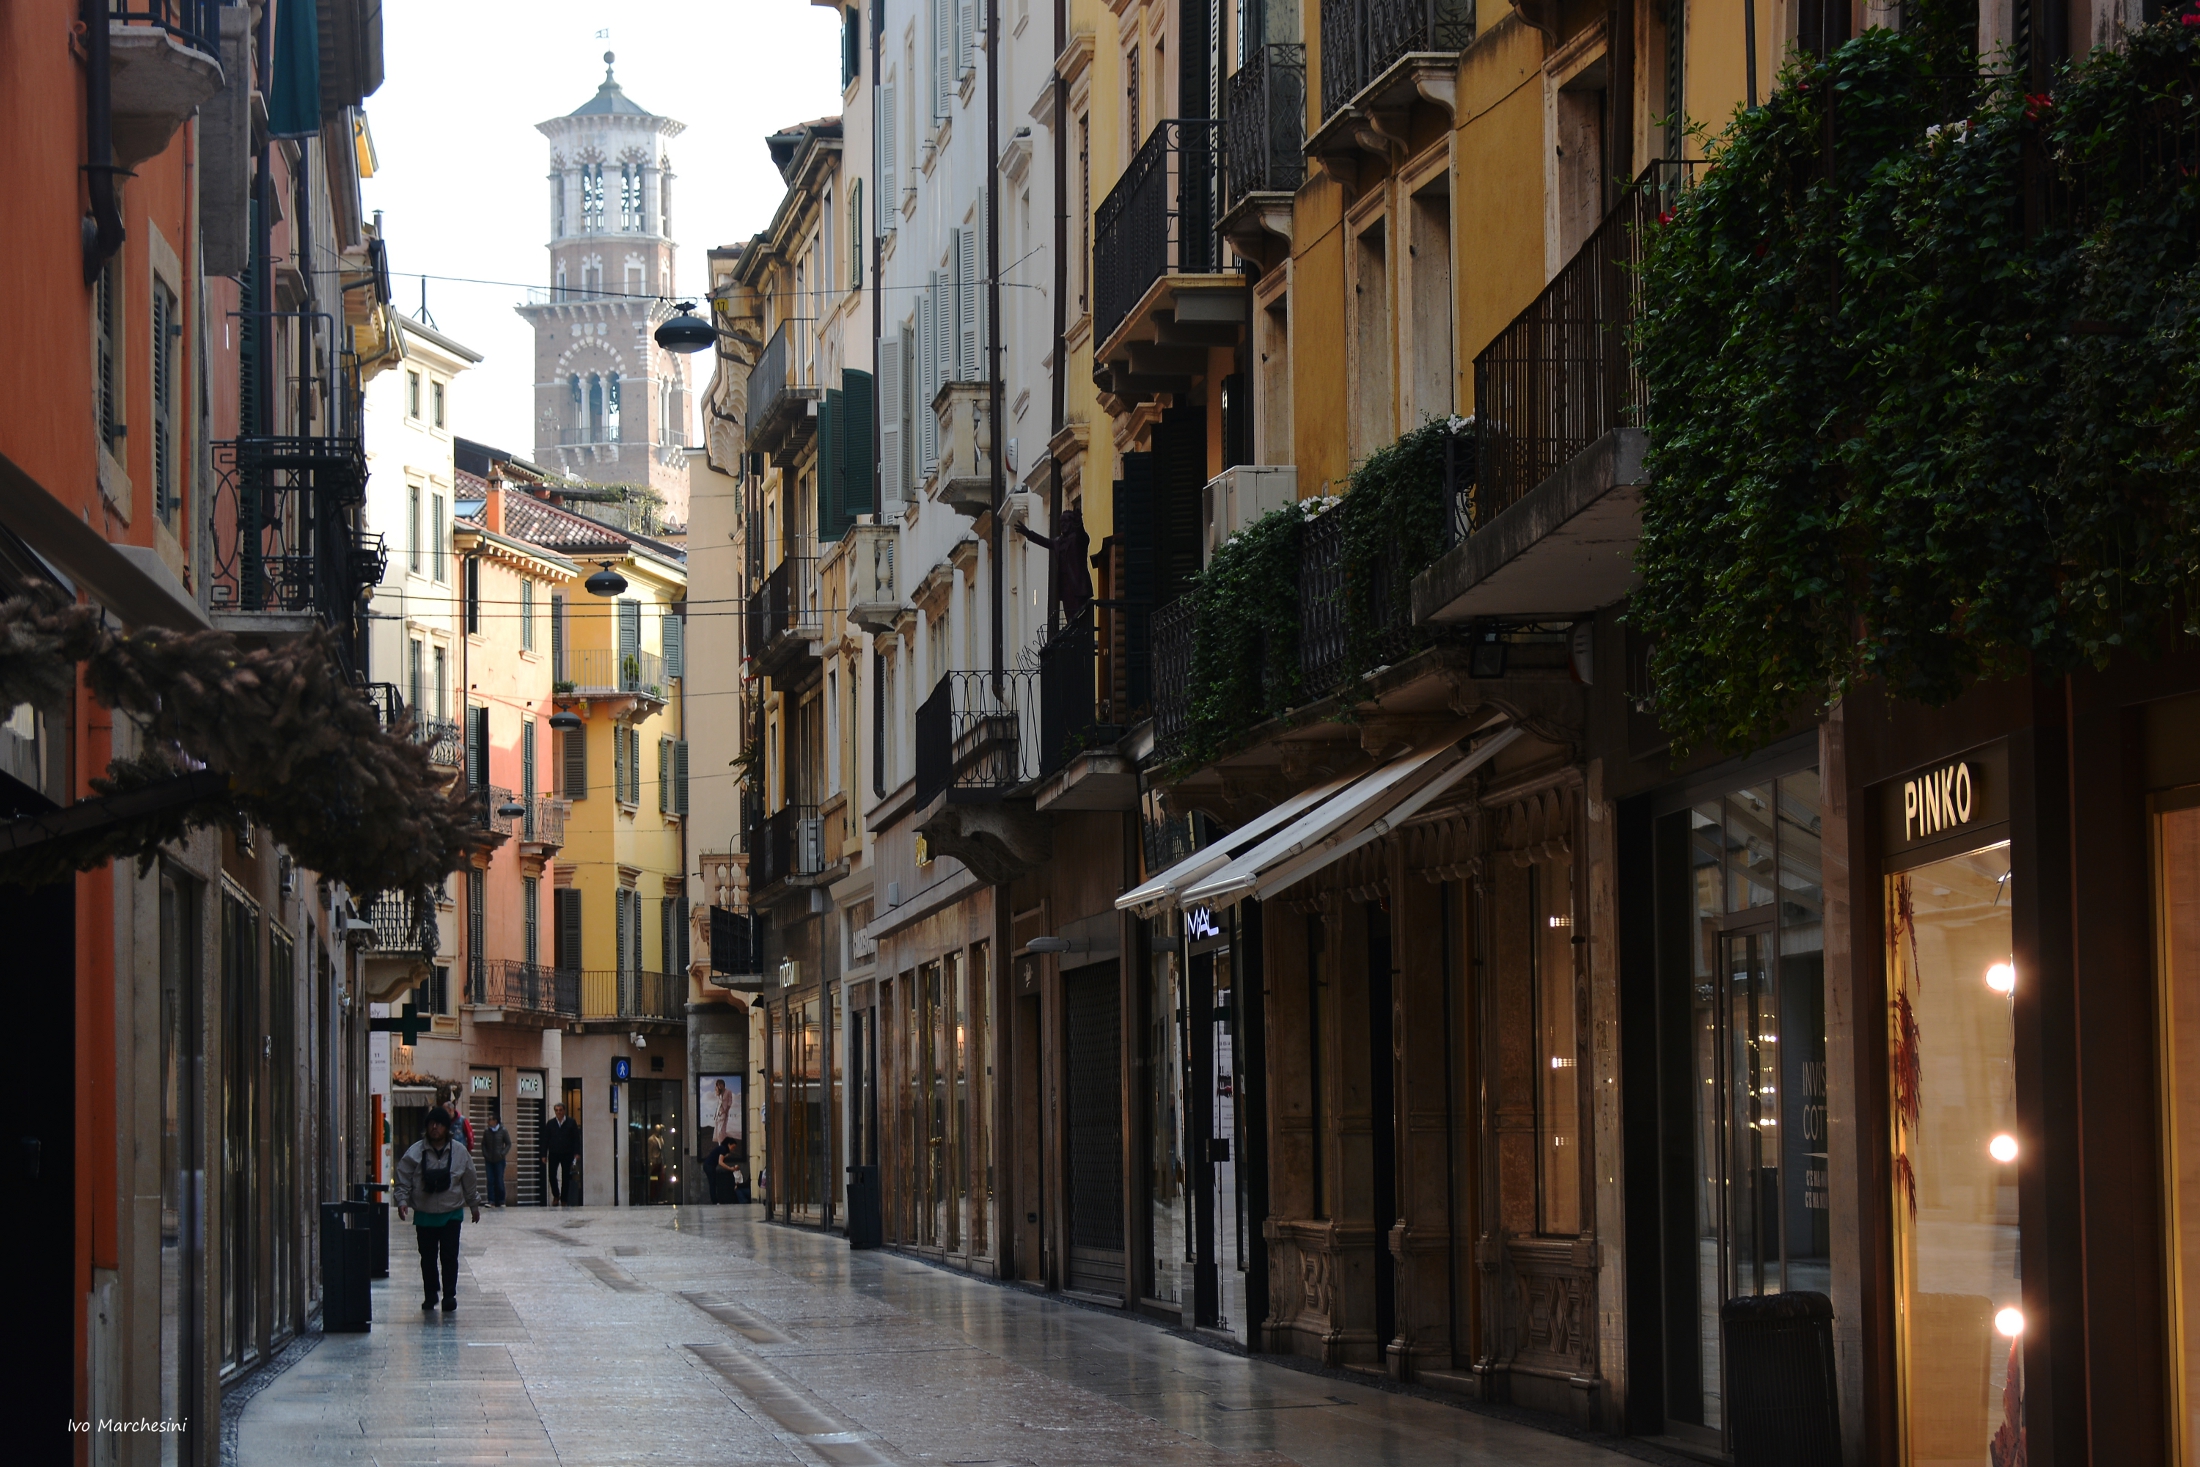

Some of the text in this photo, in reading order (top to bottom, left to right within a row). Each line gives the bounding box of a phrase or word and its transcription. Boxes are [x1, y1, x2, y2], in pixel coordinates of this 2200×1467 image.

[717, 301, 725, 312] 17
[1904, 762, 1971, 842] PINKO
[393, 1047, 414, 1066] ATERIA
[1801, 1060, 1828, 1098] INVIS
[1802, 1103, 1828, 1141] COT
